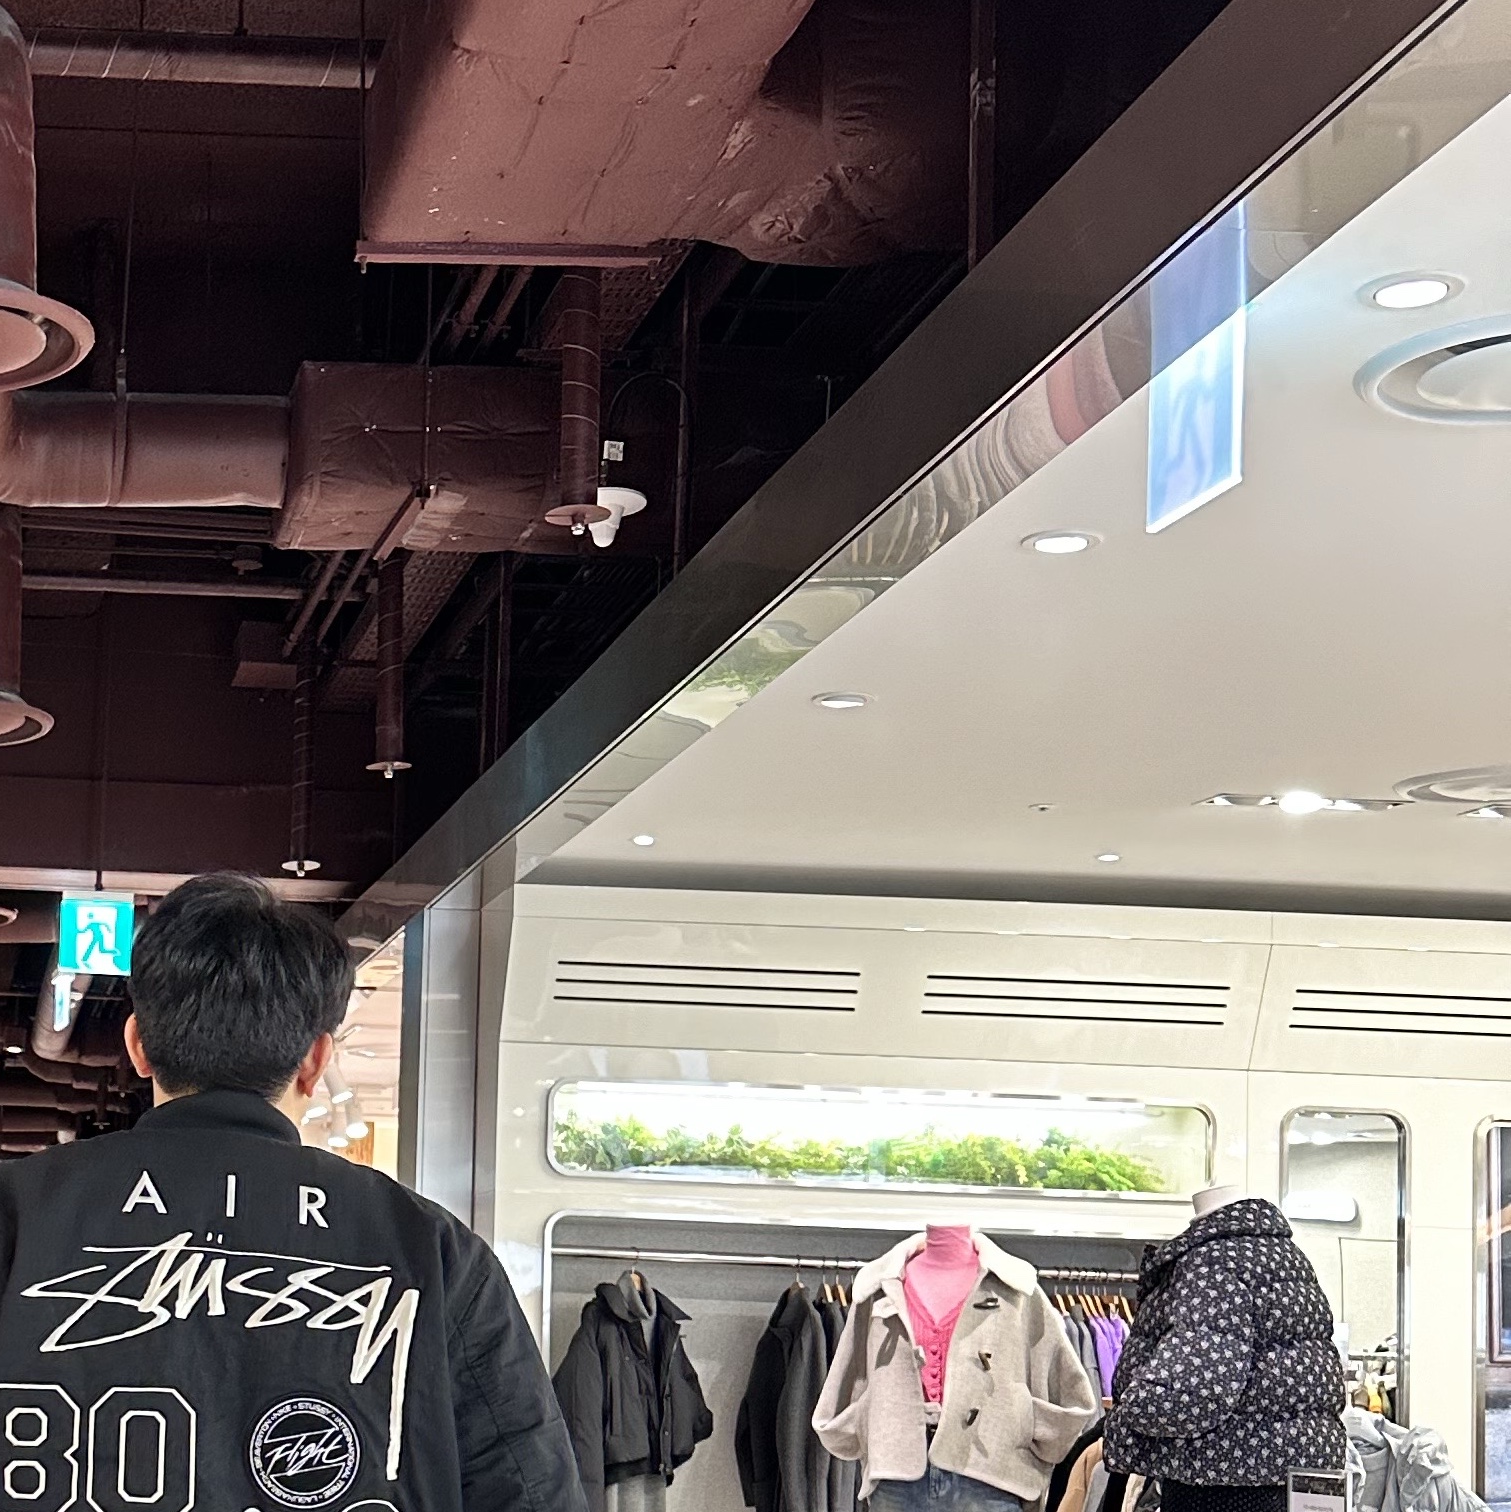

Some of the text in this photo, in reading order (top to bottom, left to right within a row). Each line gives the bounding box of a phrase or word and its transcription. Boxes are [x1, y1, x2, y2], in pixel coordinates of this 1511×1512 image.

[122, 1171, 328, 1228] AIR
[297, 1402, 331, 1417] STUSSY
[265, 1430, 349, 1476] Flight
